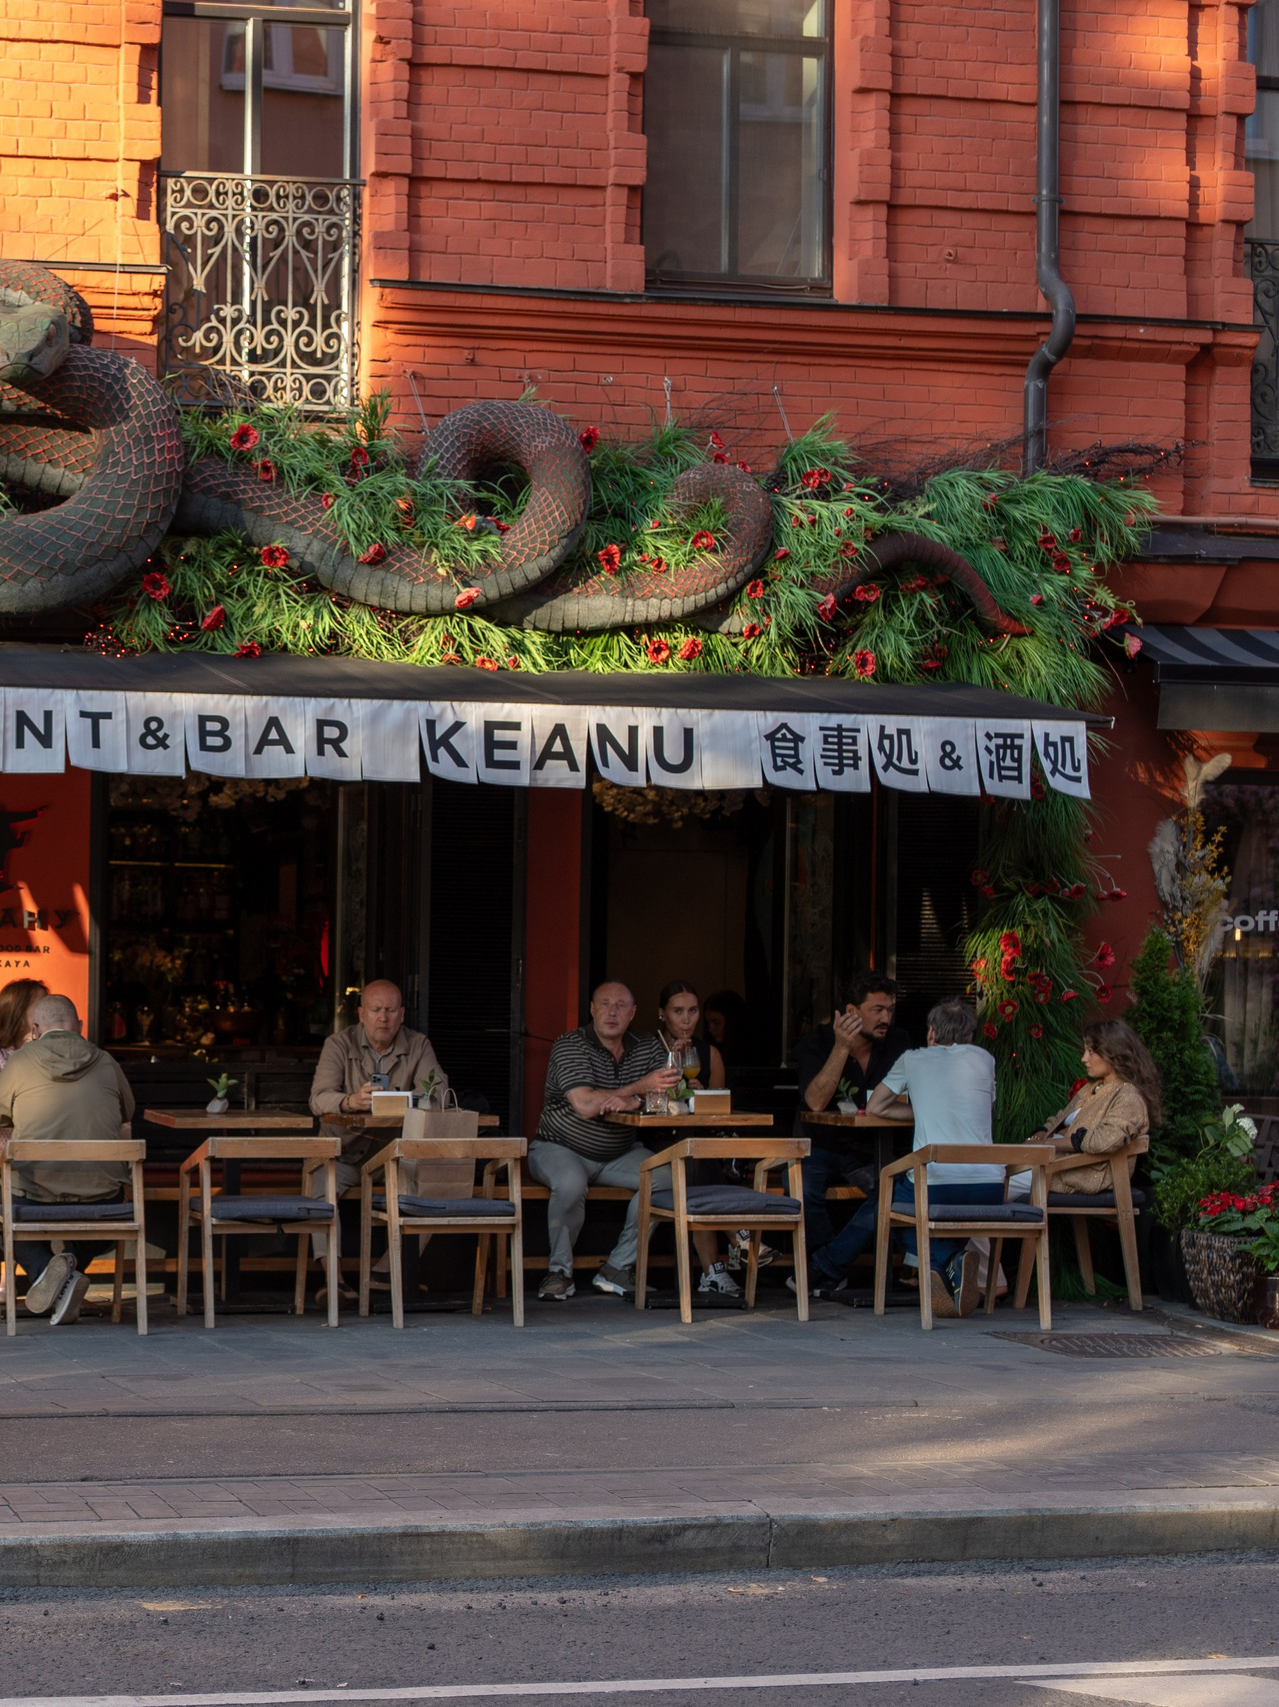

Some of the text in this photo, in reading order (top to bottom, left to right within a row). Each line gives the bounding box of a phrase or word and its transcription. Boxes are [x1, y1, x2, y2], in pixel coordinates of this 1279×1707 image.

[425, 718, 694, 774] KEANU
[1219, 909, 1279, 932] coff
[25, 945, 50, 953] BAR
